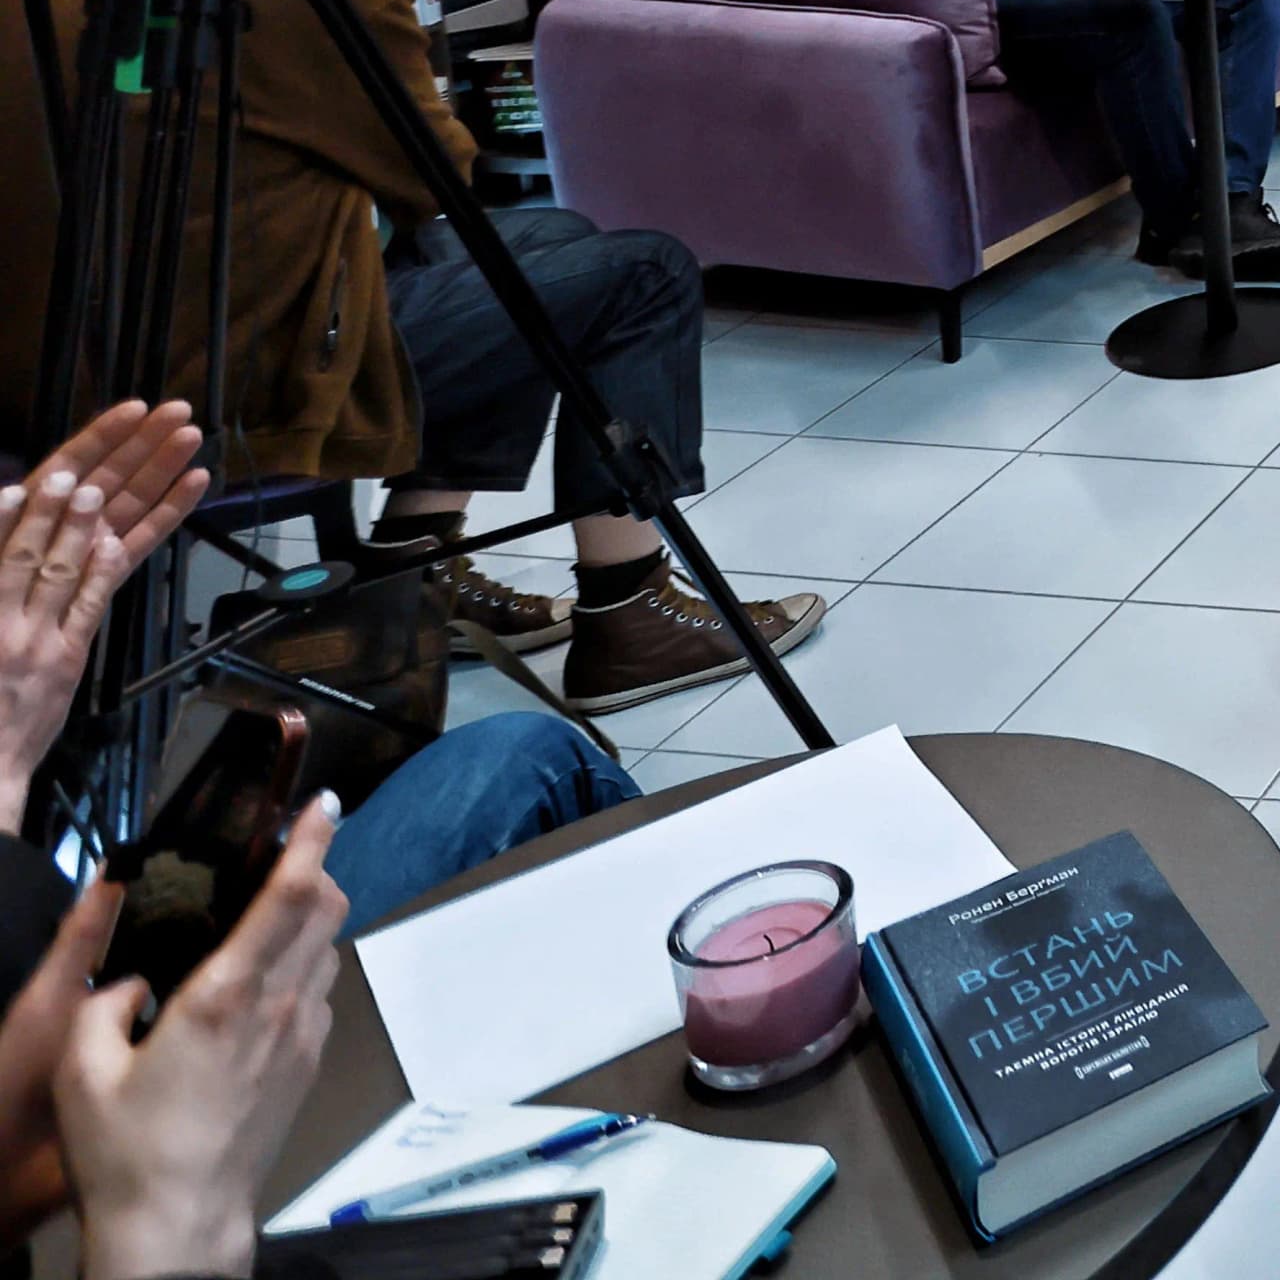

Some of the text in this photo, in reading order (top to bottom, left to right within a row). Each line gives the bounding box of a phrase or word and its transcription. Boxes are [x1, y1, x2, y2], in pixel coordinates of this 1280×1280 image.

[948, 865, 1080, 926] Ронен Берґман
[957, 909, 1135, 996] ВСТАНЬ
[984, 933, 1139, 1017] І ВБИЙ
[968, 948, 1184, 1060] ПЕРШИМ
[1040, 1009, 1160, 1071] ВОРОГІВ ІЗРАЇЛЮ
[994, 1046, 1055, 1080] ТАЄМНА
[1057, 1020, 1111, 1054] ІСТОРІЯ
